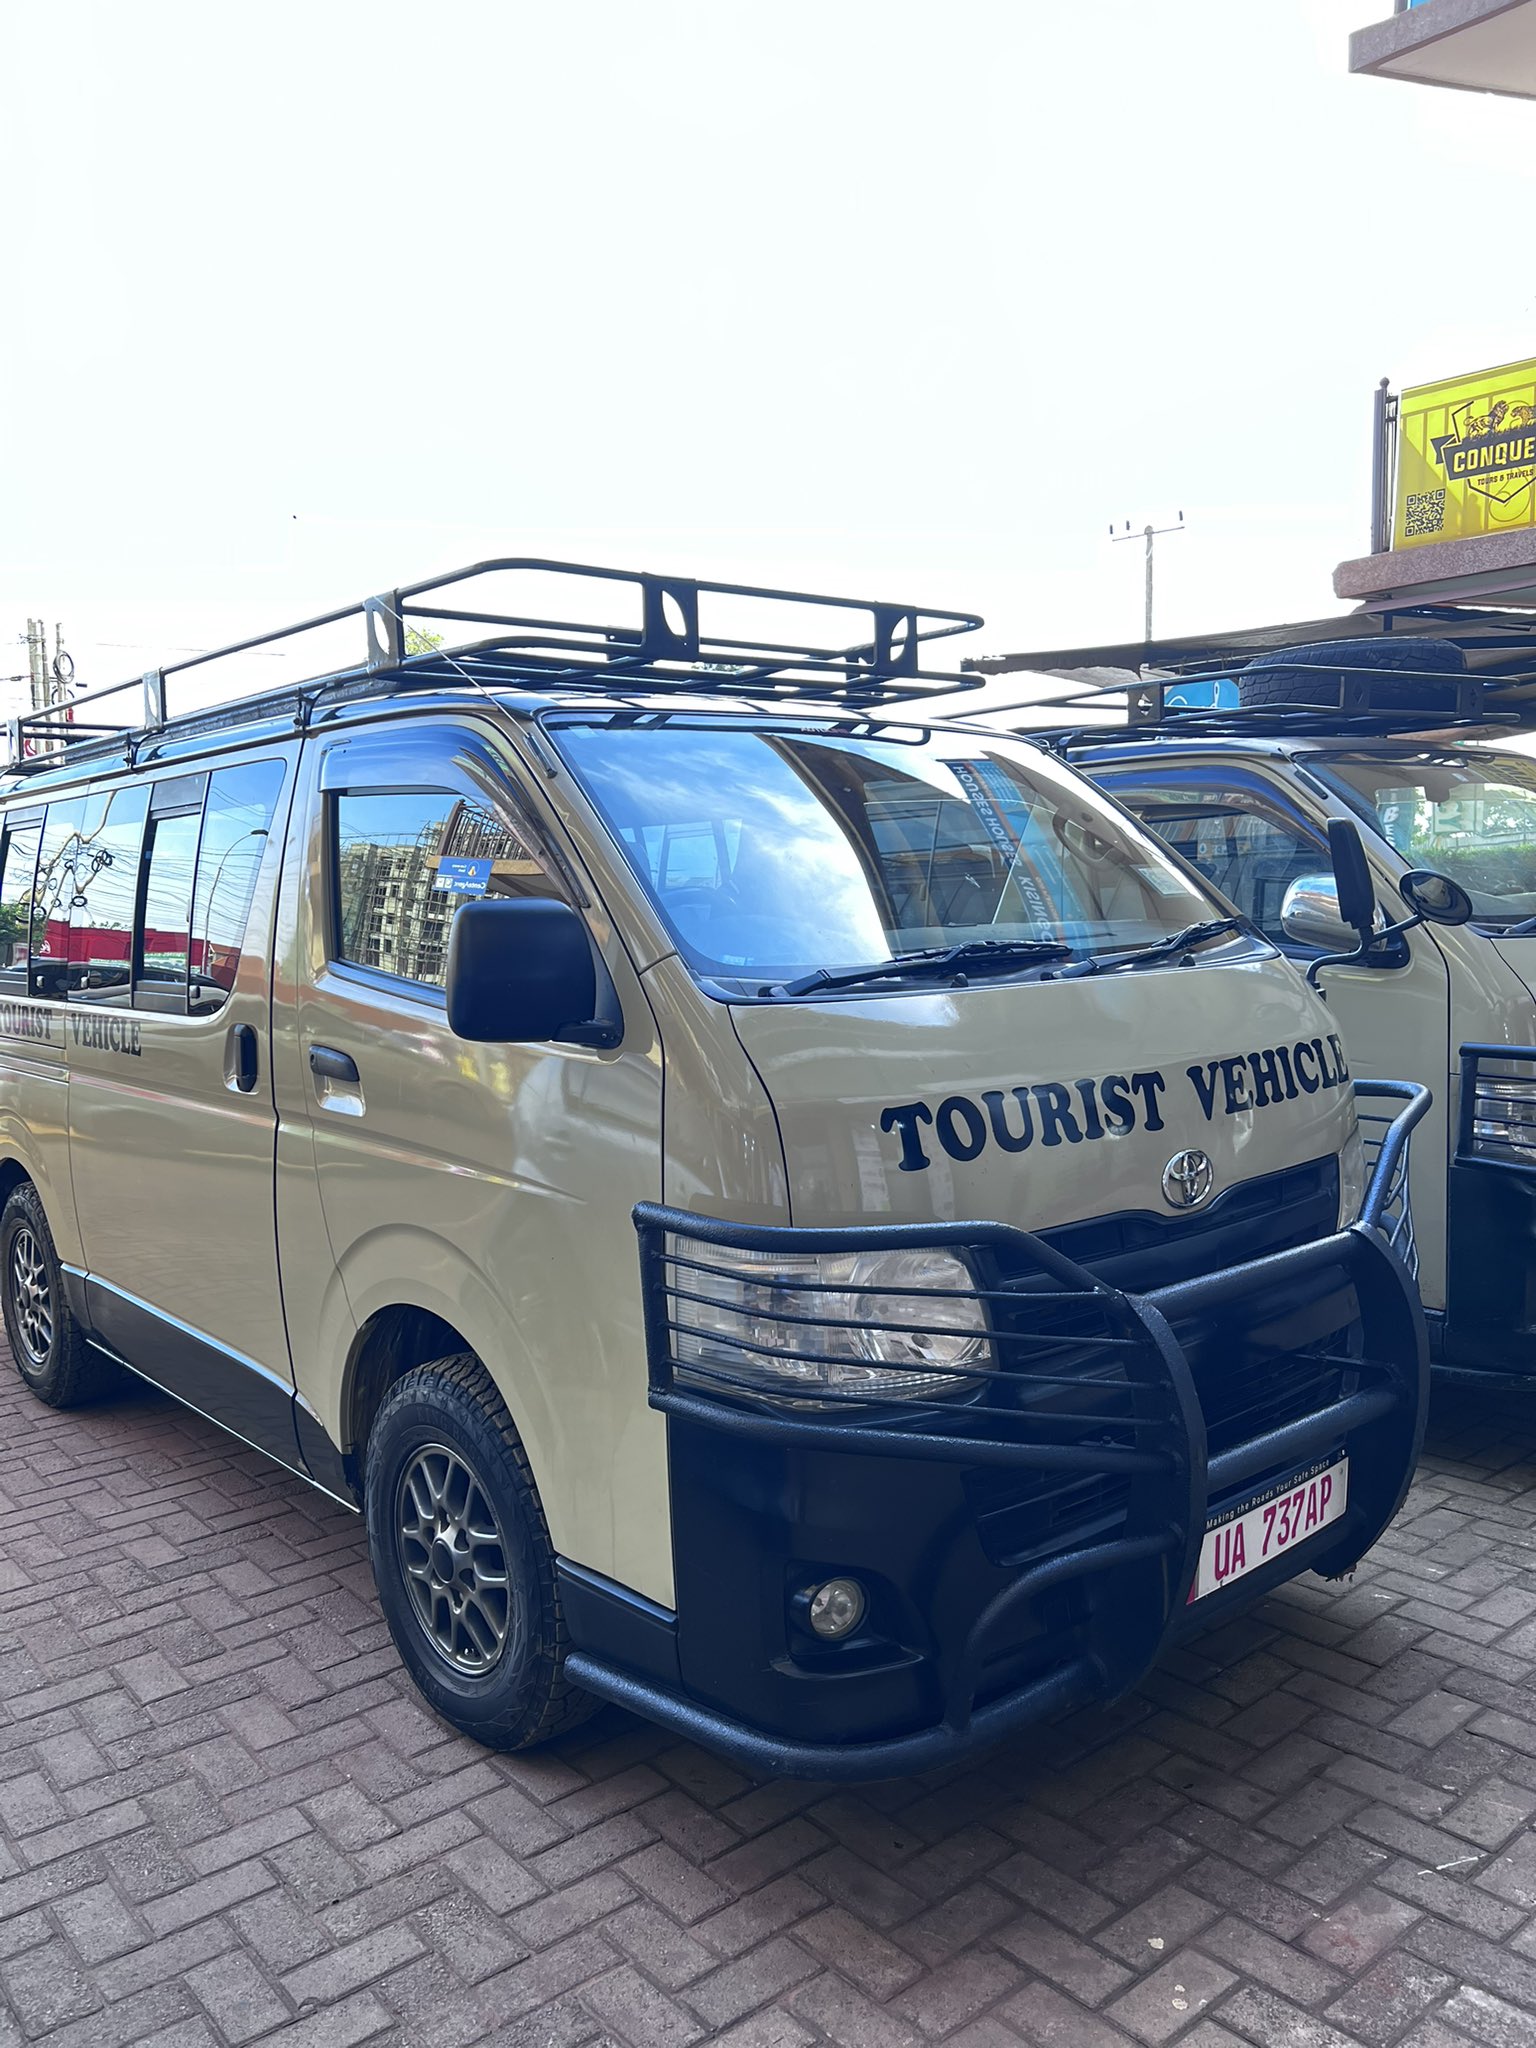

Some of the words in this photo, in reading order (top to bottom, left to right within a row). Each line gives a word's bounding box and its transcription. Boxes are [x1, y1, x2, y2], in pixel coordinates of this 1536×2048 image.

[1477, 476, 1497, 485] TOURS
[1506, 470, 1533, 480] TRAVELS
[71, 1013, 142, 1057] VEHICLE
[880, 1071, 1165, 1172] TOURIST
[1186, 1033, 1349, 1121] VEHICLE
[1205, 1510, 1235, 1529] Making
[1237, 1503, 1249, 1514] the
[1251, 1489, 1274, 1506] Roads
[1275, 1480, 1292, 1494] Your
[1293, 1472, 1309, 1484] Safe
[1310, 1459, 1330, 1475] Space
[1214, 1522, 1246, 1582] UA
[1262, 1473, 1332, 1557] 737AP
